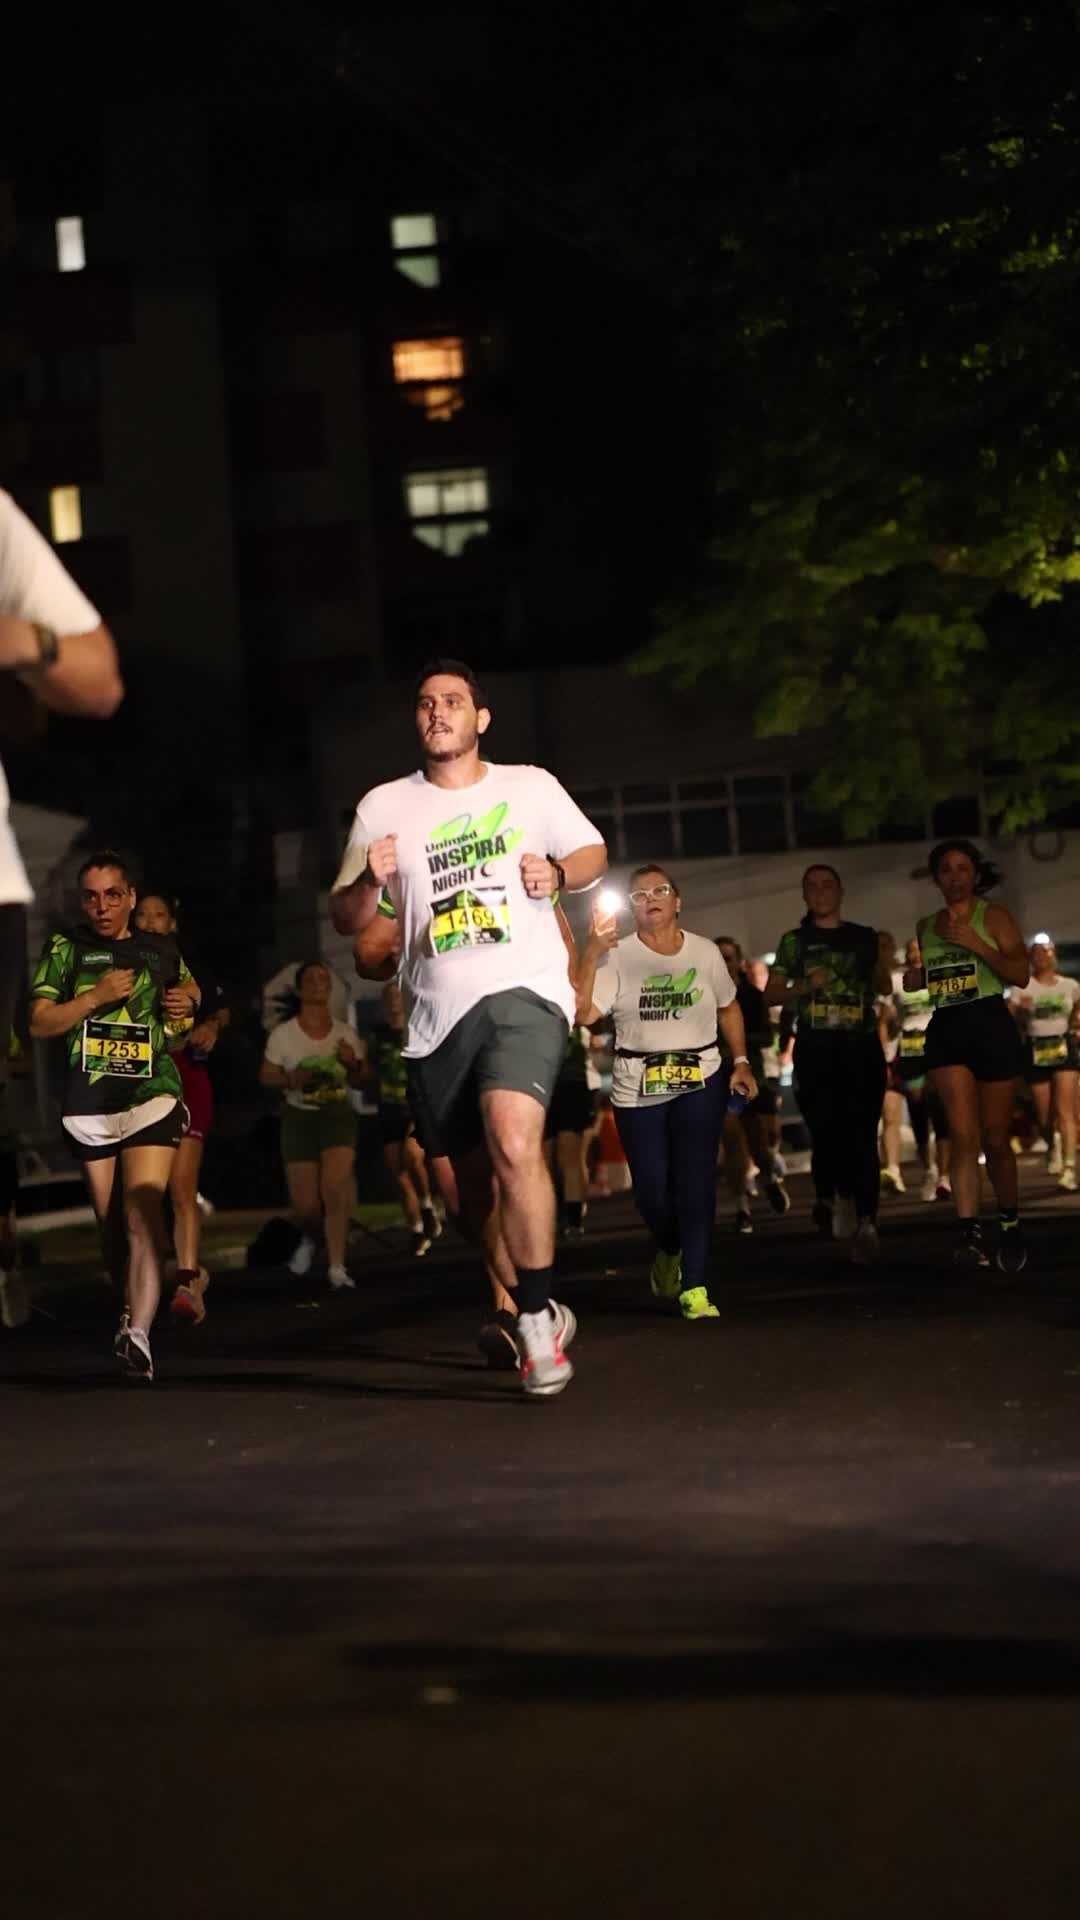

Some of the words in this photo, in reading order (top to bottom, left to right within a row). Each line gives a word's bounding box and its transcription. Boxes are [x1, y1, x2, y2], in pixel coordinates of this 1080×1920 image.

[425, 830, 478, 853] Unimed
[427, 834, 507, 875] INSPIRA
[432, 866, 476, 894] NIGHT
[449, 908, 495, 930] 1469
[936, 977, 967, 993] 2187
[639, 993, 692, 1008] INSPIRA
[639, 1010, 671, 1021] NIGHT
[97, 1040, 140, 1058] 1253
[656, 1066, 693, 1081] 1542
